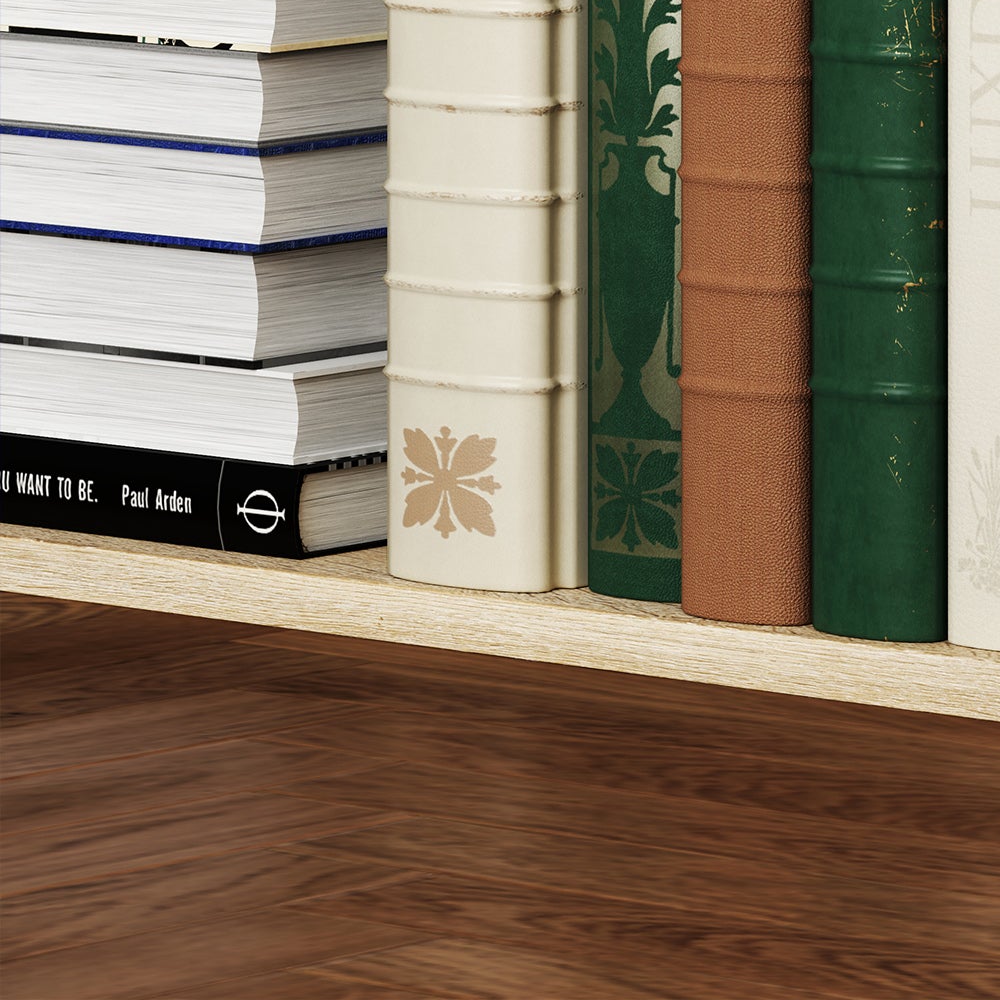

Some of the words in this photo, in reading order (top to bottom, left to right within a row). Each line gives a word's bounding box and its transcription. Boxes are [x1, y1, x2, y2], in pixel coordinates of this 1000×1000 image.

[0, 470, 10, 493] U
[16, 472, 52, 498] WANT
[57, 476, 72, 500] TO
[78, 479, 99, 504] BE.
[121, 484, 149, 509] Paul
[155, 488, 192, 514] Arden
